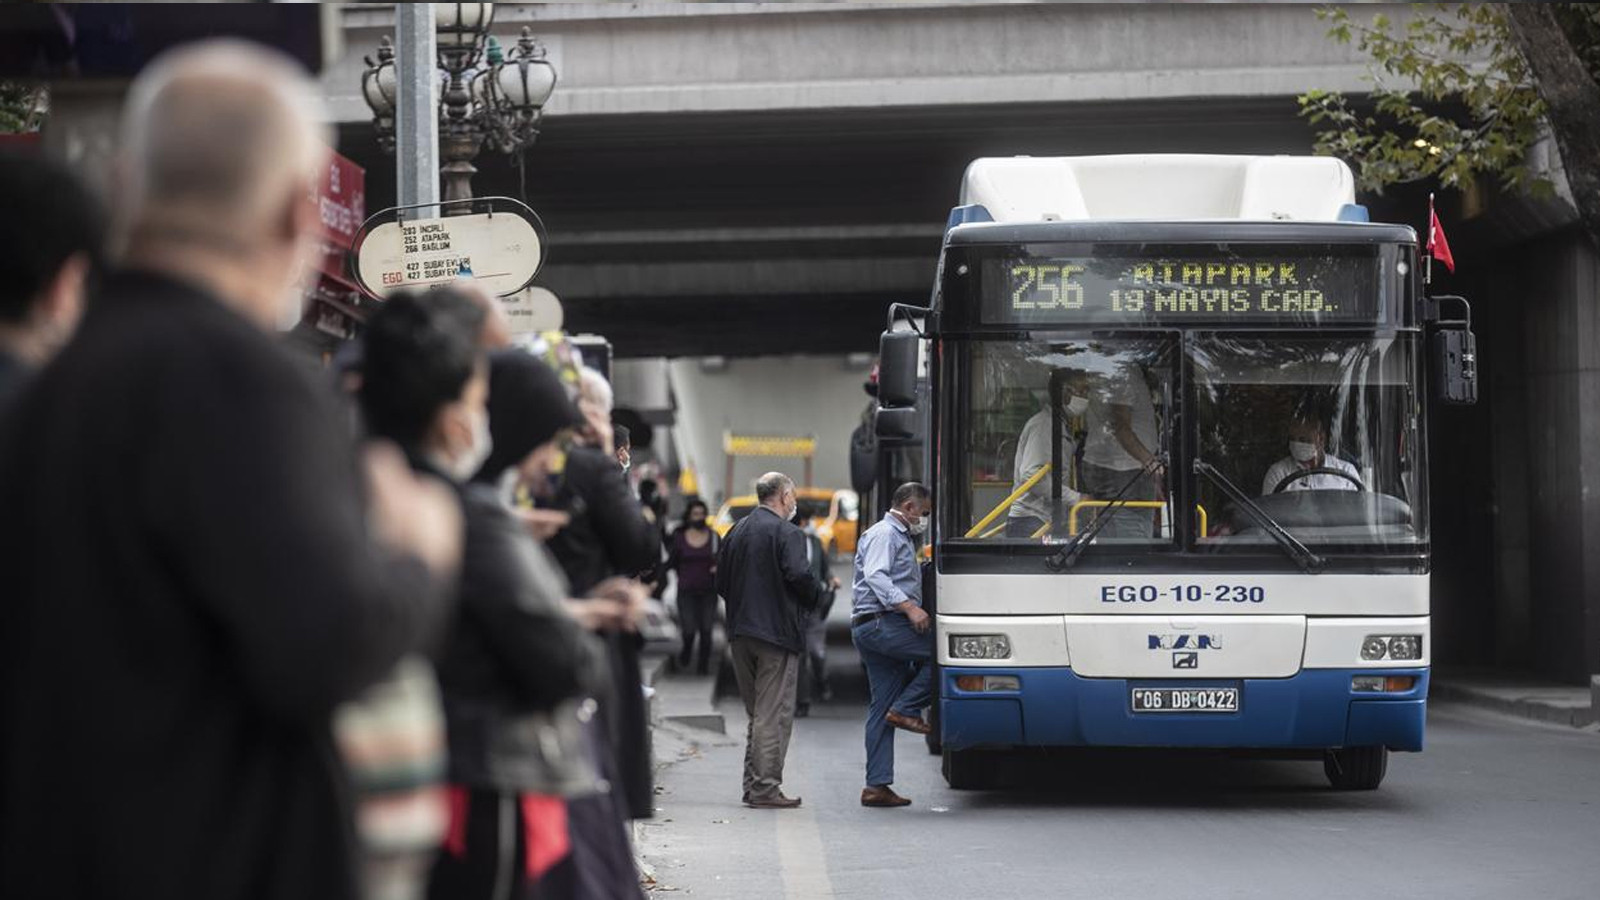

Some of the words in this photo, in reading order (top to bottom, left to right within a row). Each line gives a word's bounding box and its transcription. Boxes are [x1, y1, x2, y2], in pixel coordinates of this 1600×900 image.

[404, 236, 417, 244] 252
[421, 232, 451, 242] ATAPARK
[406, 262, 419, 270] 427
[424, 259, 445, 269] SUBAY
[382, 272, 403, 284] EGO
[408, 271, 420, 280] 427
[425, 269, 445, 278] SUBAY
[1134, 262, 1299, 284] ATAPARK
[1012, 265, 1084, 309] 256
[1109, 289, 1144, 311] 19
[1154, 289, 1250, 311] MAYIS
[1101, 585, 1264, 603] EGO-10-230
[1148, 634, 1222, 650] MAN
[1143, 691, 1162, 708] 06
[1172, 691, 1191, 708] DB
[1199, 691, 1235, 708] 0422
